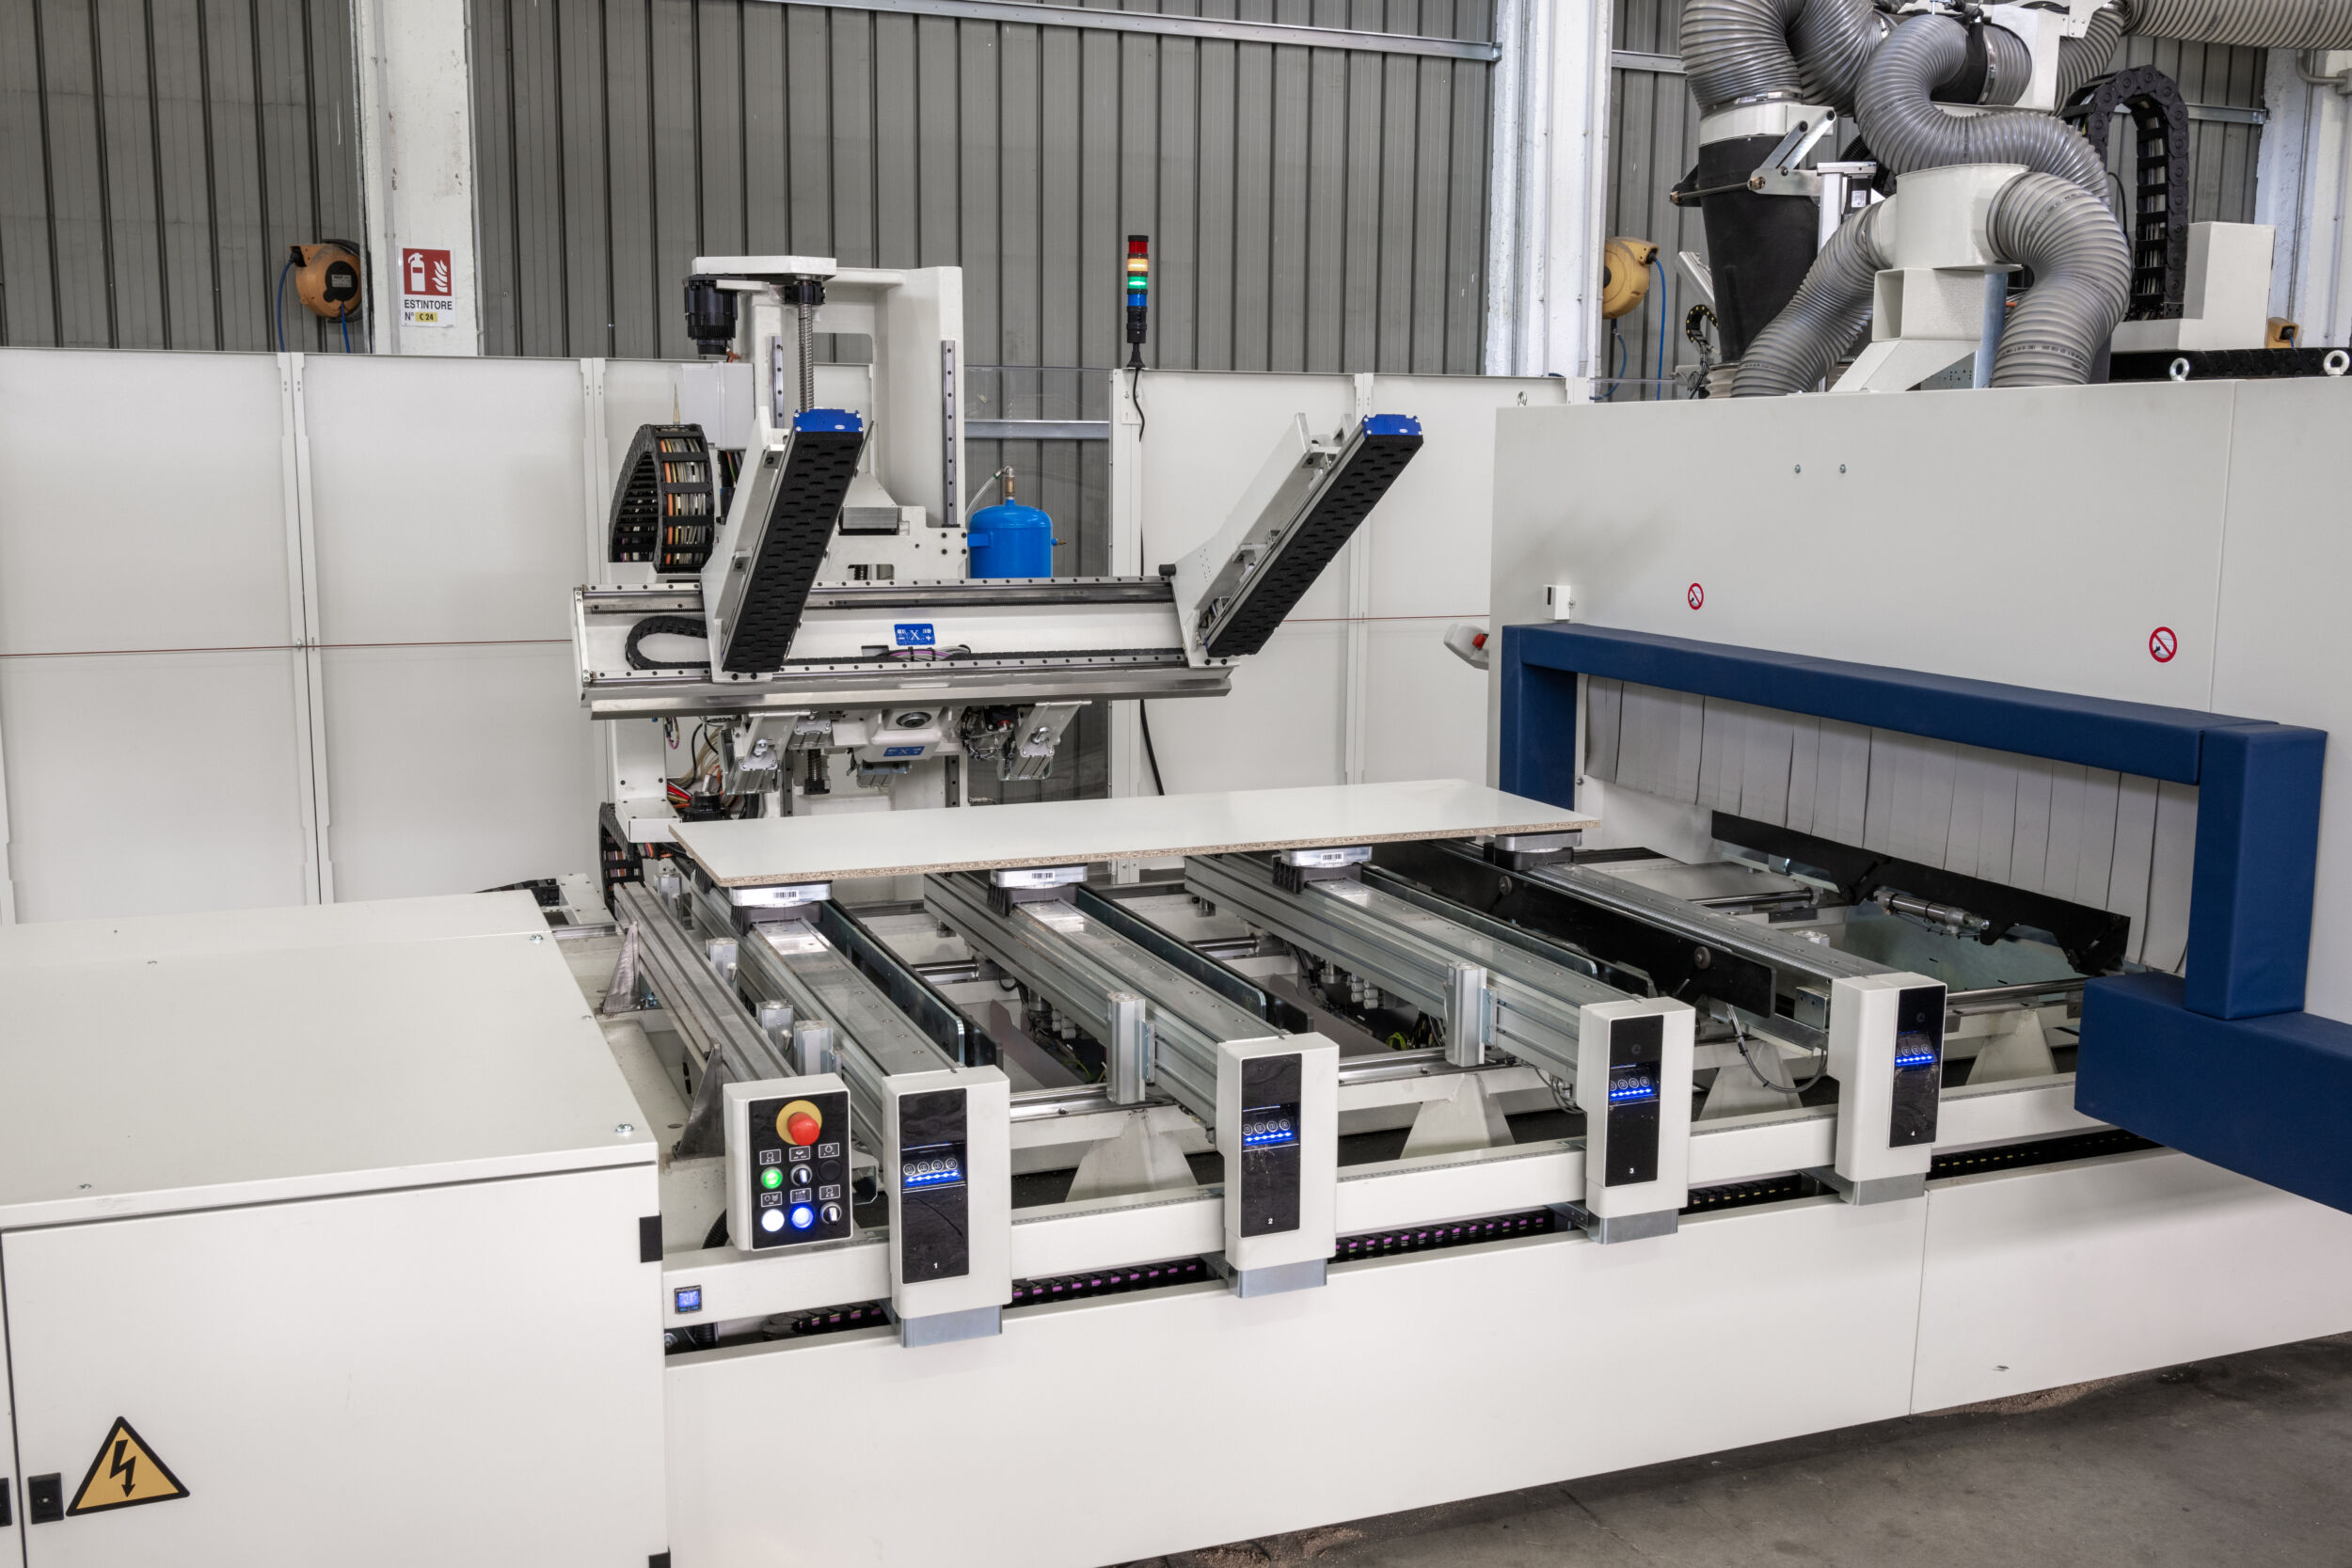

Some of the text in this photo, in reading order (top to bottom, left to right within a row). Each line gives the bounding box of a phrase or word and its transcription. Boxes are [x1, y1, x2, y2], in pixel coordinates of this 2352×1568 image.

[405, 299, 453, 310] ESTINTORE
[405, 311, 414, 321] N°
[910, 629, 921, 641] X
